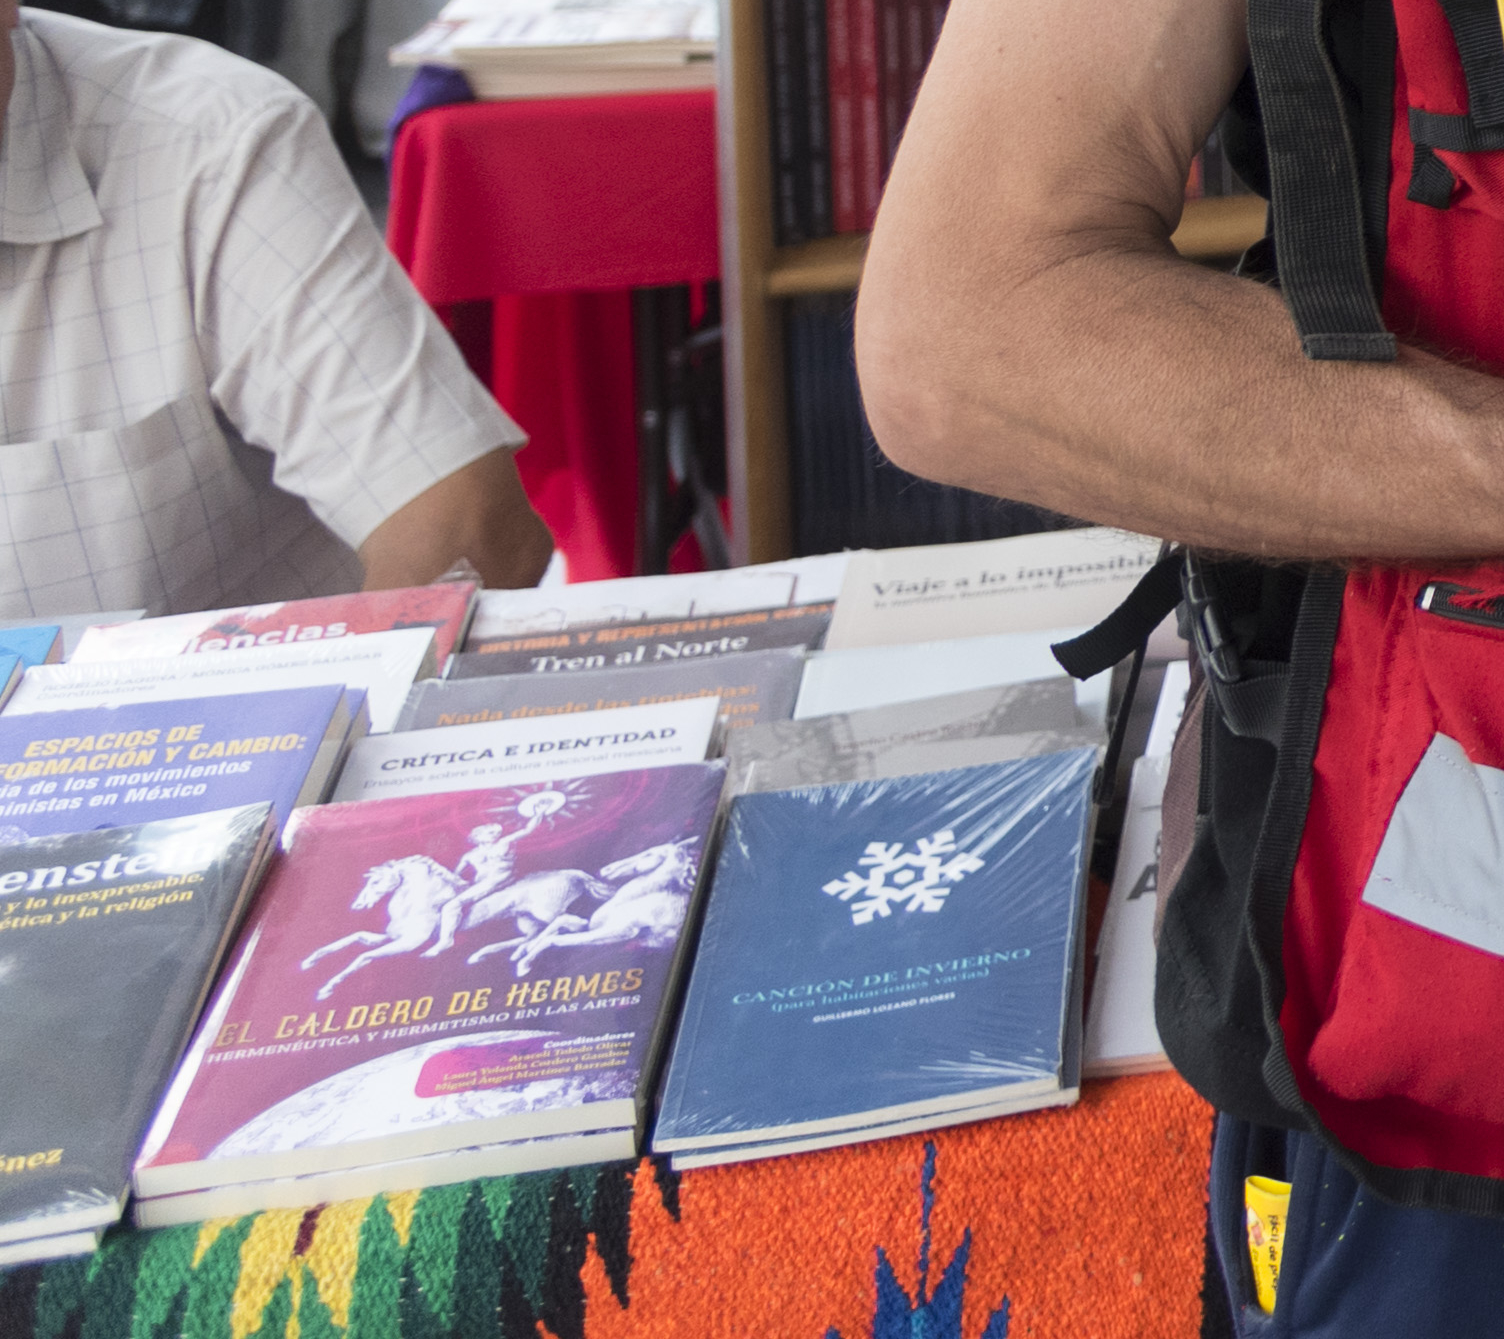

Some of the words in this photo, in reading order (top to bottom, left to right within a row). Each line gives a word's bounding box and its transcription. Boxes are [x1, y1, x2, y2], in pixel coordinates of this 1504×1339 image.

[872, 577, 947, 599] Viaje
[976, 571, 1008, 587] lo
[530, 653, 605, 673] Tren
[615, 649, 645, 666] al
[653, 634, 749, 661] Norte
[510, 702, 574, 719] desde
[25, 728, 162, 758] ESPACIOS
[166, 724, 205, 743] DE
[165, 745, 183, 764] Y
[188, 733, 307, 760] CAMBIO:
[381, 739, 495, 772] CRÍTICA
[527, 726, 677, 755] IDENTIDAD
[29, 779, 59, 797] de
[63, 775, 99, 793] los
[105, 758, 254, 787] movimientos
[362, 771, 424, 789] Ensayos
[428, 766, 469, 783] sobre
[490, 758, 542, 775] cultura
[546, 752, 608, 770] nacional
[611, 743, 683, 762] mexicana
[90, 792, 119, 809] en
[125, 780, 208, 805] México
[25, 895, 50, 911] lo
[77, 902, 99, 919] la
[104, 888, 194, 916] religión
[731, 977, 857, 1006] CANCIÓN
[863, 969, 899, 987] DE
[904, 947, 1032, 980] INVIERNO
[770, 996, 816, 1014] (para
[820, 978, 929, 1007] habitaciones
[933, 966, 991, 988] vacías)
[213, 1022, 251, 1050] EL
[275, 994, 435, 1040] CALDERO
[446, 987, 493, 1017] DE
[505, 967, 646, 1008] HERMES
[812, 1006, 872, 1024] GUILLERMO
[873, 999, 918, 1016] LOZANO
[919, 991, 956, 1007] FLORES
[206, 1033, 362, 1064] HERMENÉUTICA
[382, 1011, 511, 1041] HERMETISMO
[515, 1006, 540, 1022] EN
[543, 1001, 579, 1017] LAS
[580, 993, 642, 1013] ARTES
[543, 1031, 637, 1051] Coordinadores
